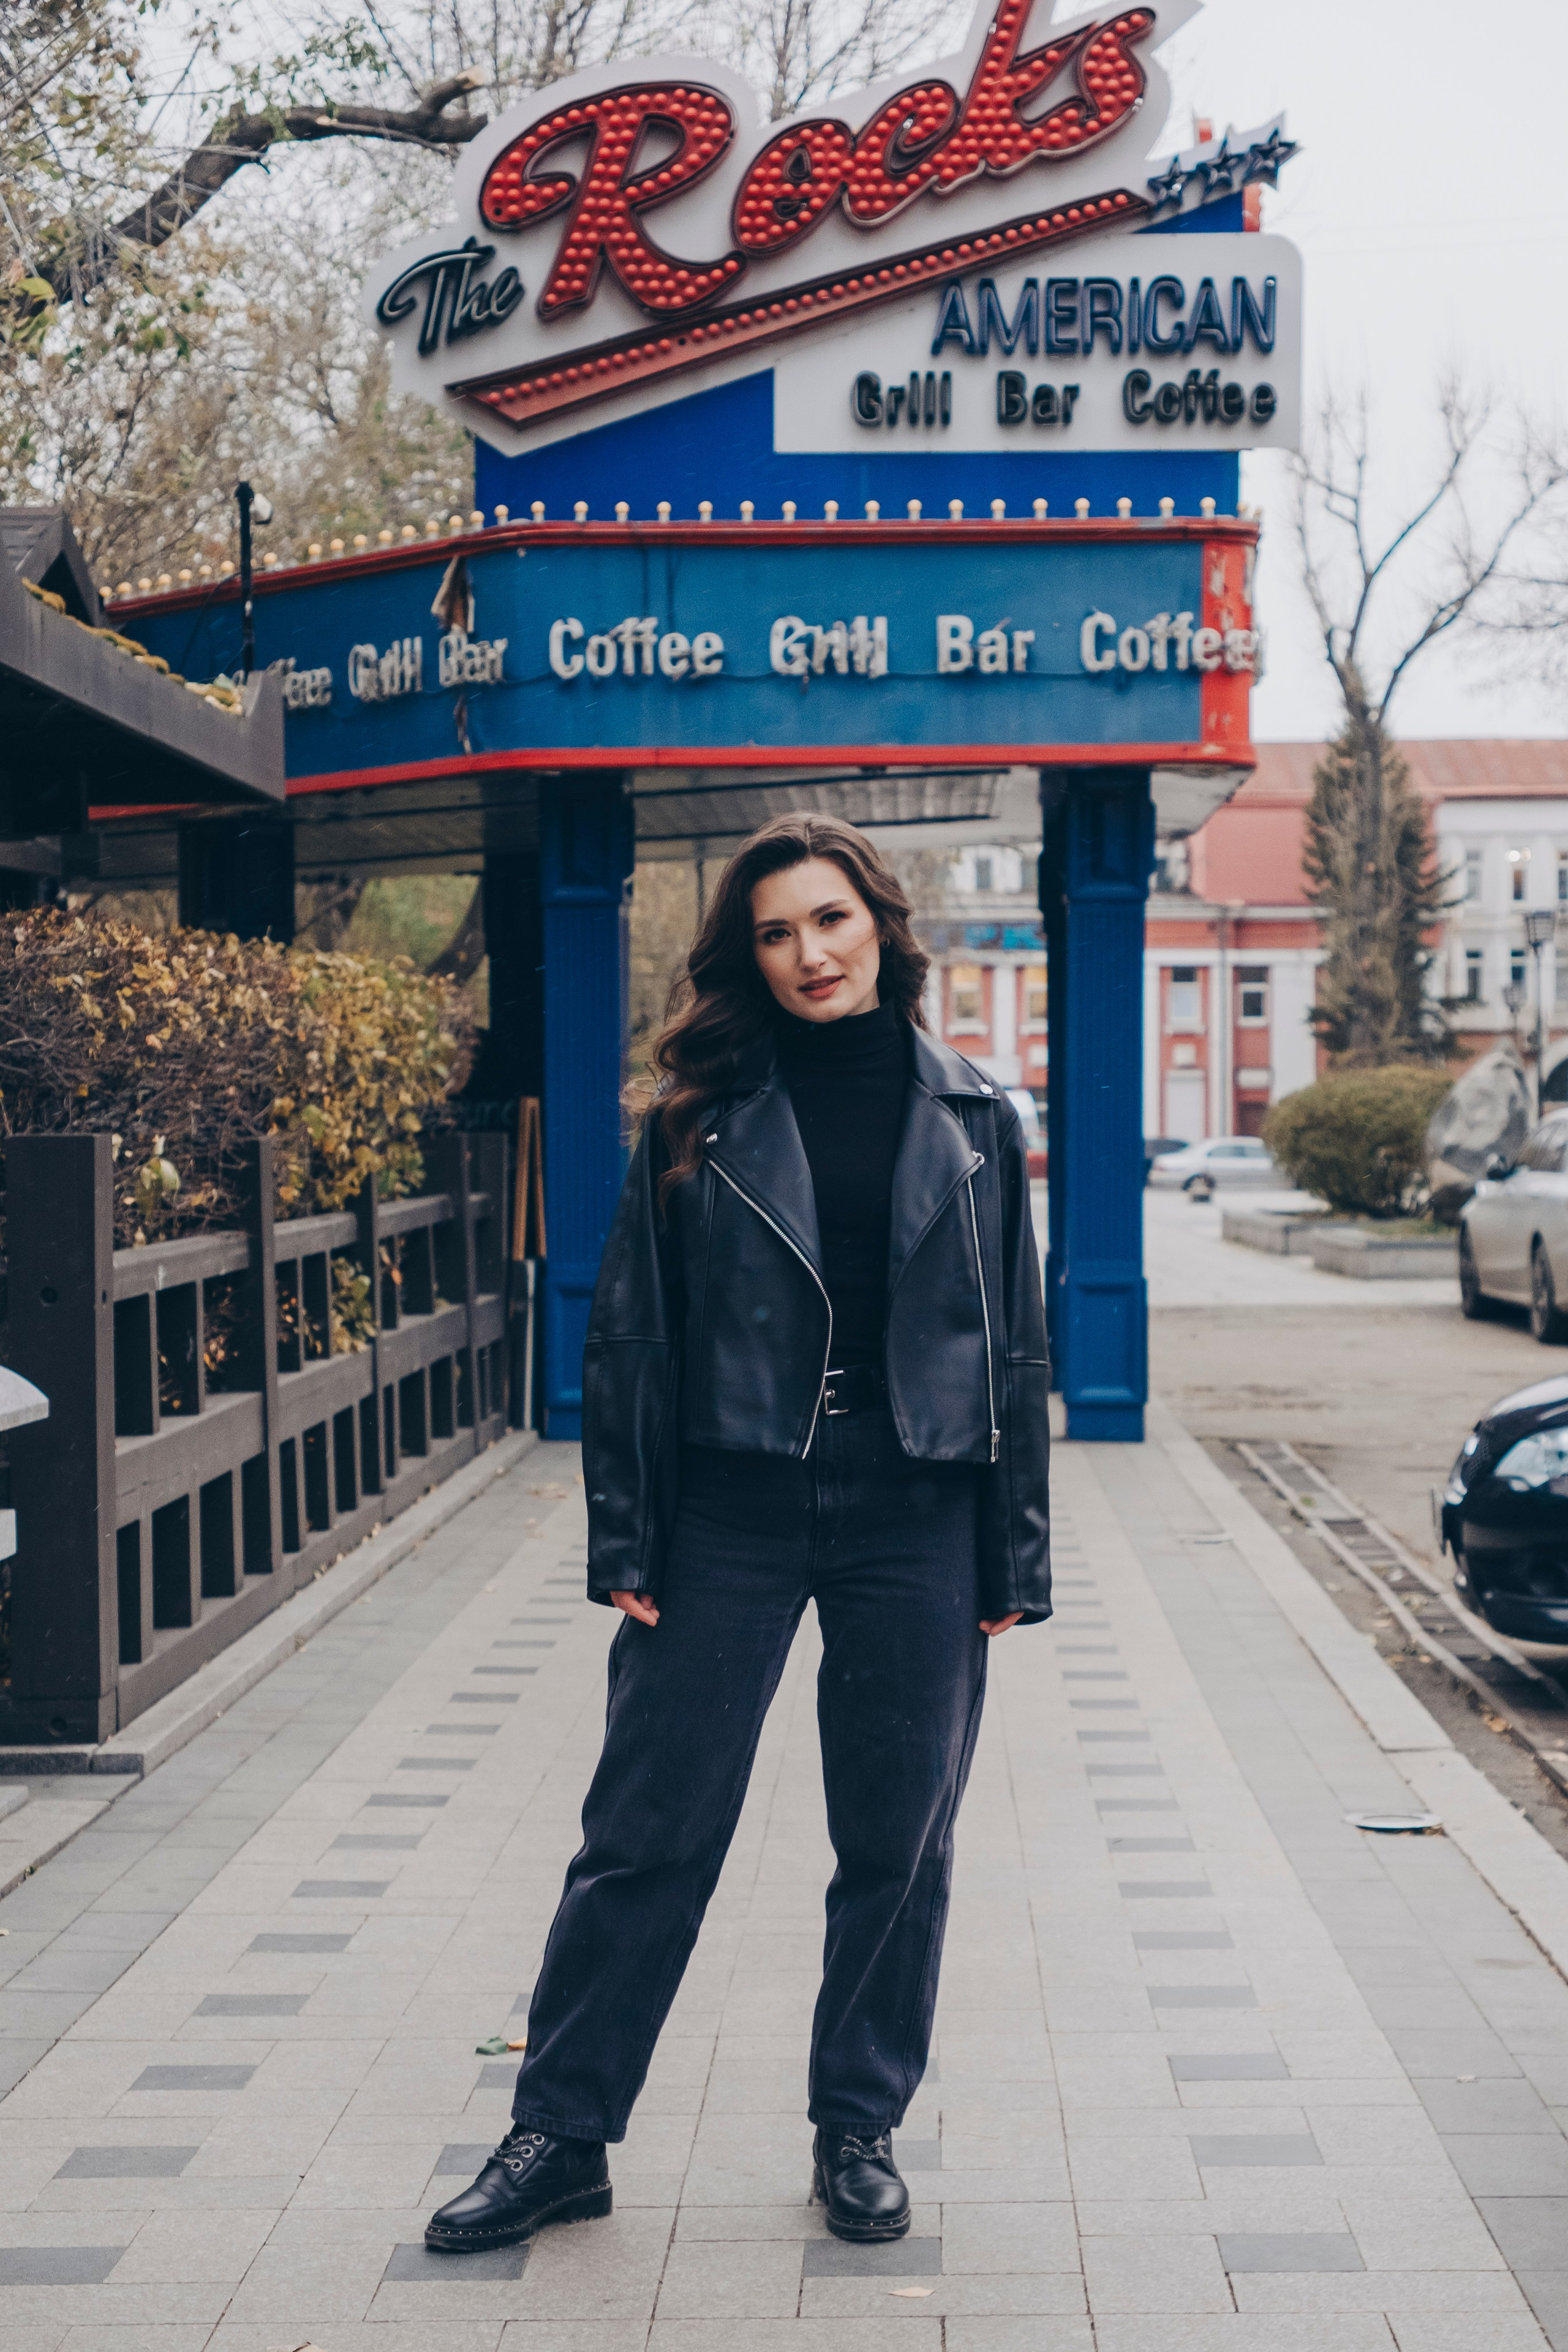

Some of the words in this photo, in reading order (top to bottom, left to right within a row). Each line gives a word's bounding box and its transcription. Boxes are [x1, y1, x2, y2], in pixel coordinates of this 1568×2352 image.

[376, 235, 525, 356] The
[931, 276, 1276, 355] AMERICAN
[851, 371, 951, 427] Grill
[997, 371, 1079, 426] Bar
[1123, 368, 1277, 424] Coffee
[348, 636, 423, 702] Grill
[439, 634, 508, 687] Bar
[549, 617, 725, 680] Coffee
[769, 616, 888, 677] Grill
[937, 614, 1034, 674] Bar
[1081, 611, 1265, 673] Coffee
